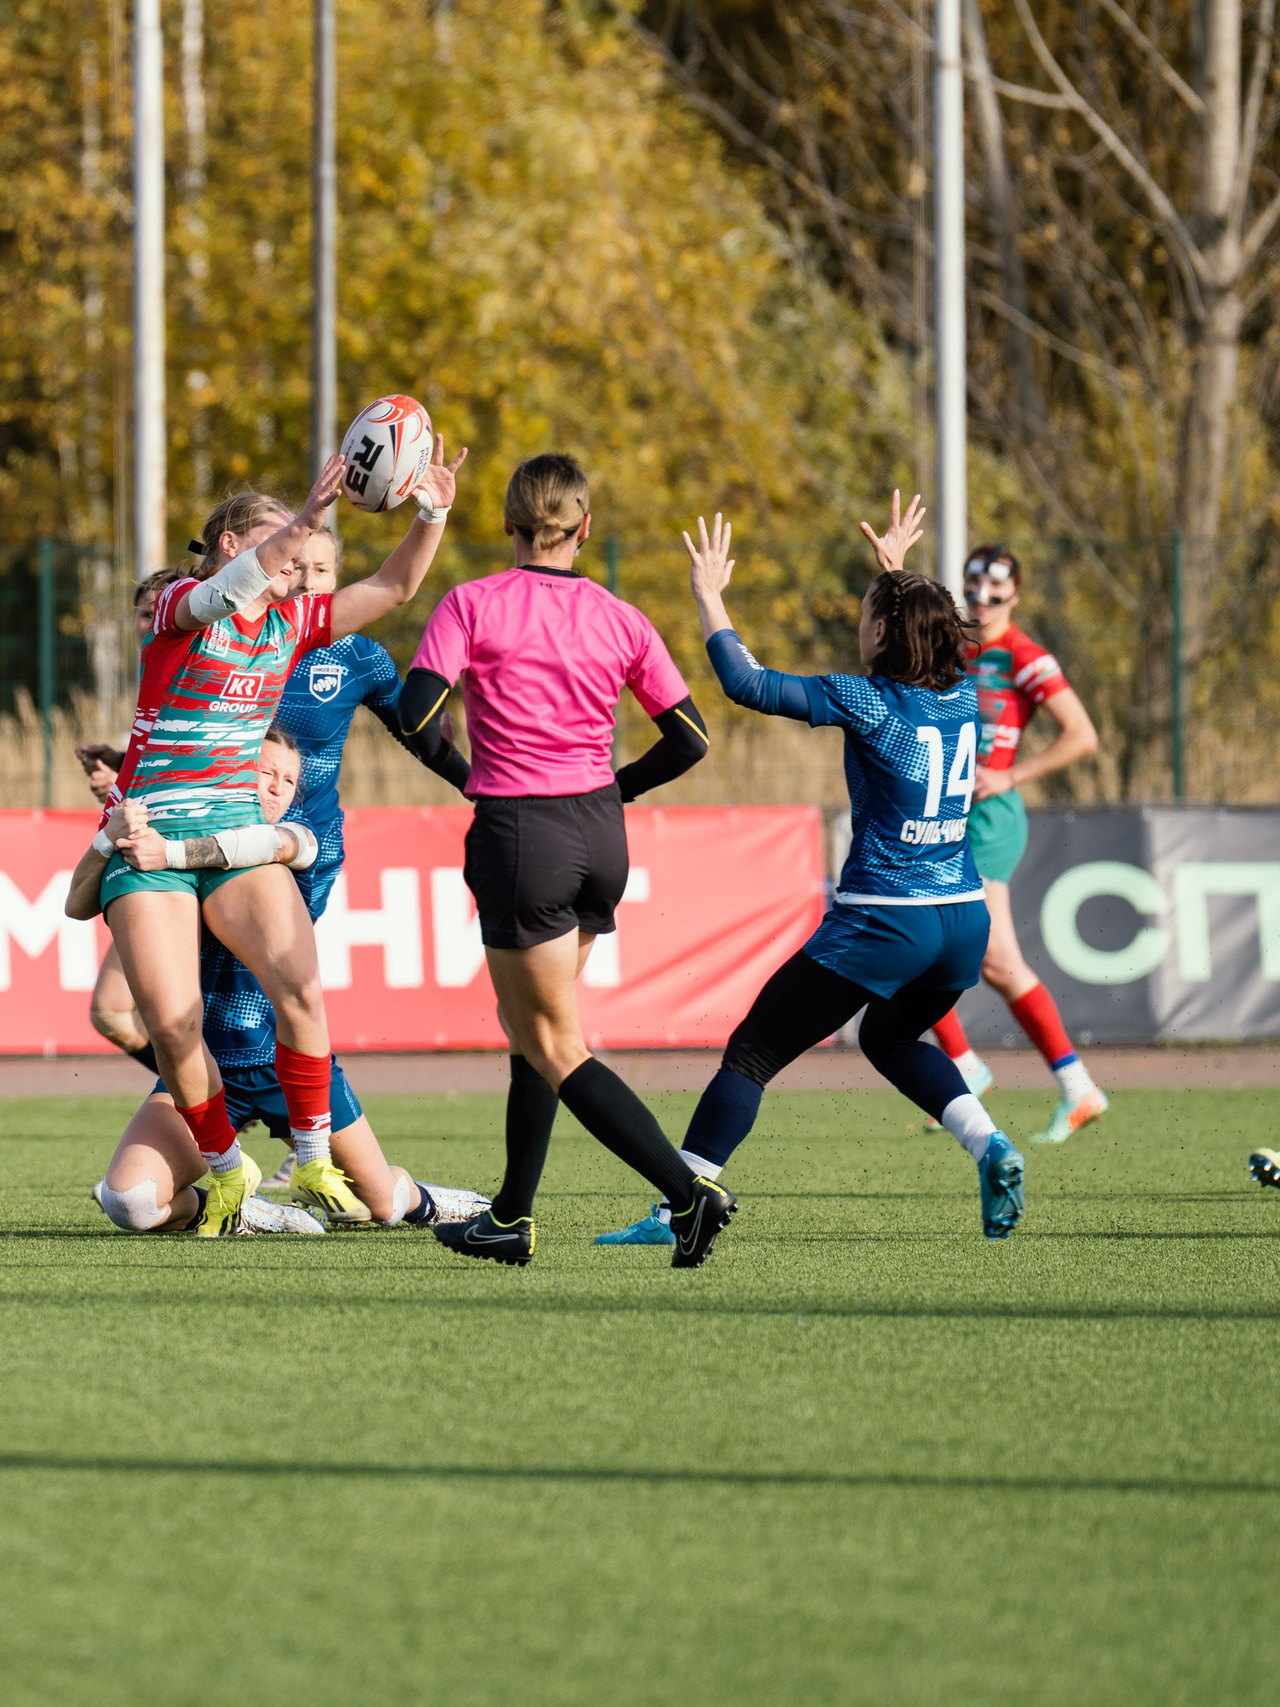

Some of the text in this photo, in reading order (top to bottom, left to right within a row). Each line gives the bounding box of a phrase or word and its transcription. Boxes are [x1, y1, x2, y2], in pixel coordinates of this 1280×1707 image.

[345, 434, 385, 497] R3
[208, 701, 258, 713] GROUP
[227, 677, 256, 696] KR
[917, 721, 977, 817] 14
[1040, 861, 1280, 985] СП
